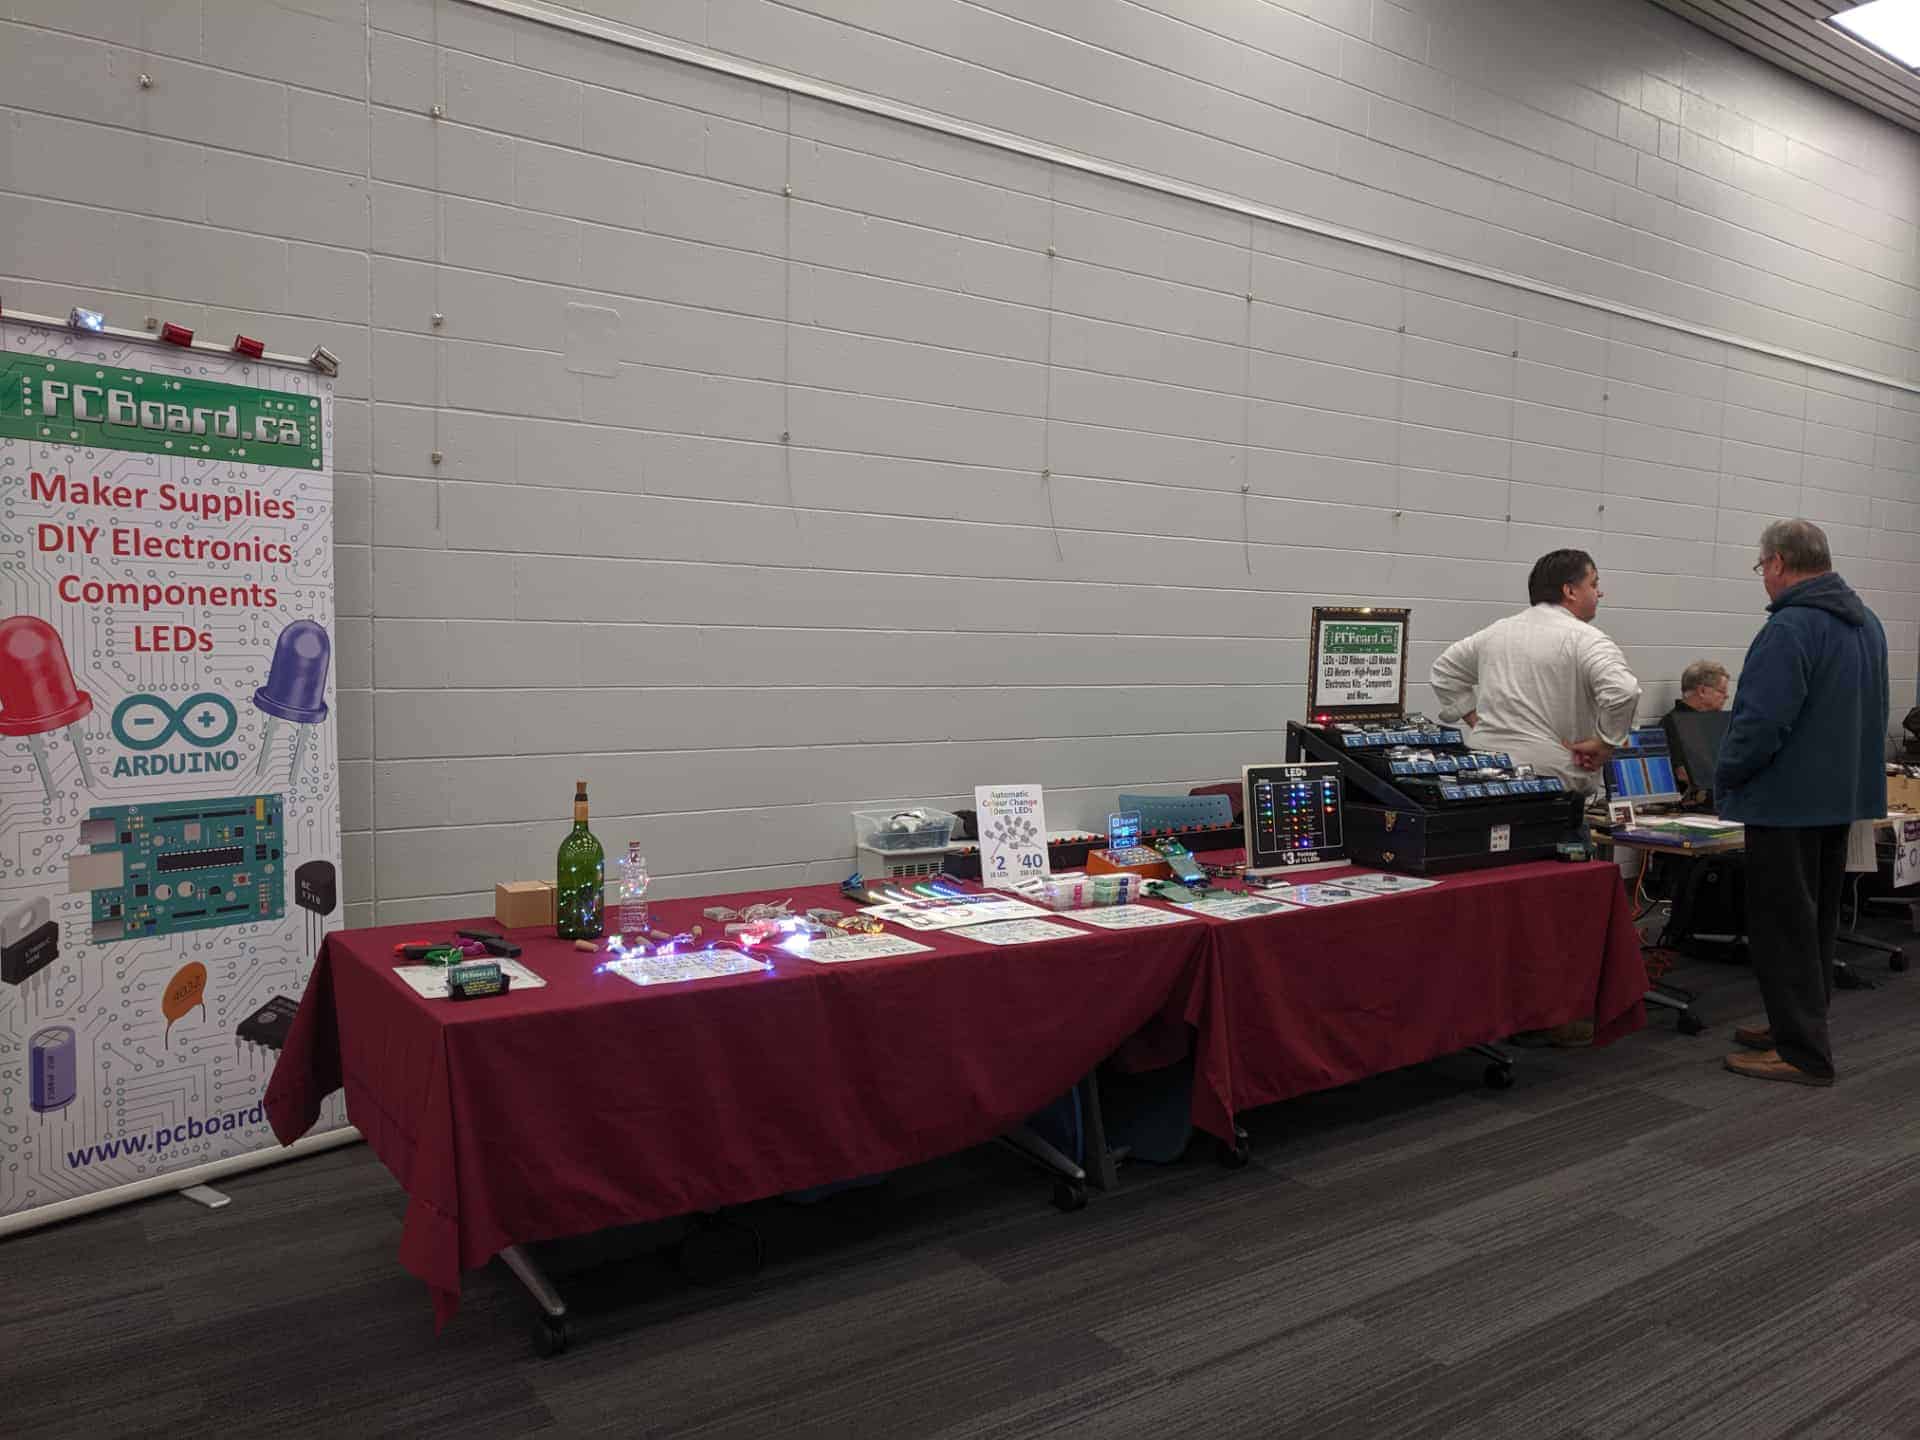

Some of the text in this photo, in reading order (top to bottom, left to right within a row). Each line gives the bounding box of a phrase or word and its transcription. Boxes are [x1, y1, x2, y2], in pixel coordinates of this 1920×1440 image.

[42, 380, 301, 446] PCBoard.ca
[30, 472, 296, 521] Maker Supplies
[38, 523, 293, 564] DIY Electronics
[58, 575, 278, 611] Components
[134, 625, 214, 652] LEDs
[1324, 667, 1333, 677] LED
[1338, 655, 1348, 665] LED
[112, 750, 239, 778] ARDUINO
[1284, 767, 1307, 777] LEDs
[1009, 798, 1037, 808] Change
[1014, 806, 1033, 814] LEDs
